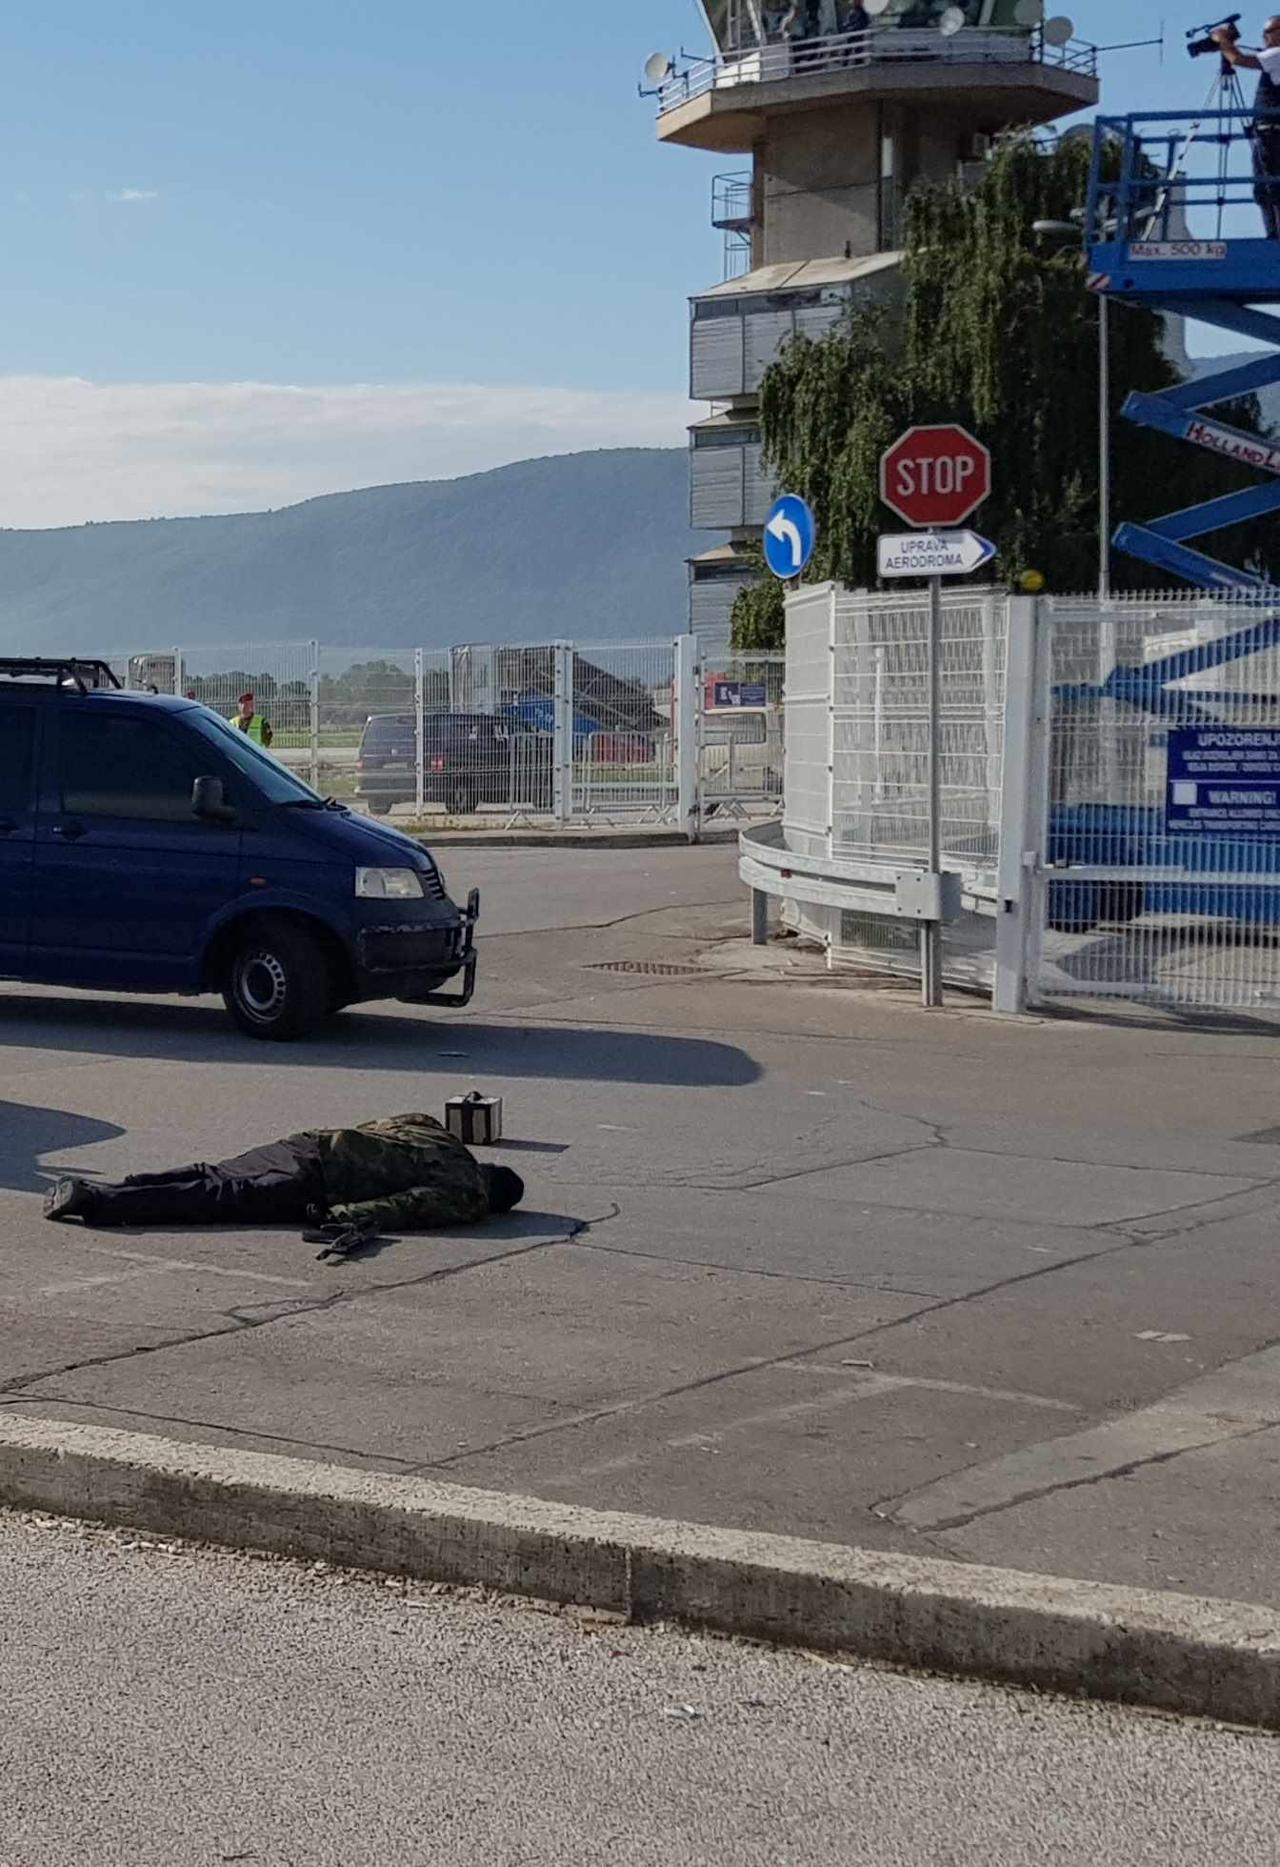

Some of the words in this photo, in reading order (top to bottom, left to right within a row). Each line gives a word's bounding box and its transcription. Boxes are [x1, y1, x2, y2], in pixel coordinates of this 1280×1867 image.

[1171, 243, 1201, 256] 500
[896, 455, 975, 496] STOP
[900, 539, 950, 554] UPRAVA
[885, 553, 964, 570] AERODROMA
[1208, 790, 1277, 805] WARNING!
